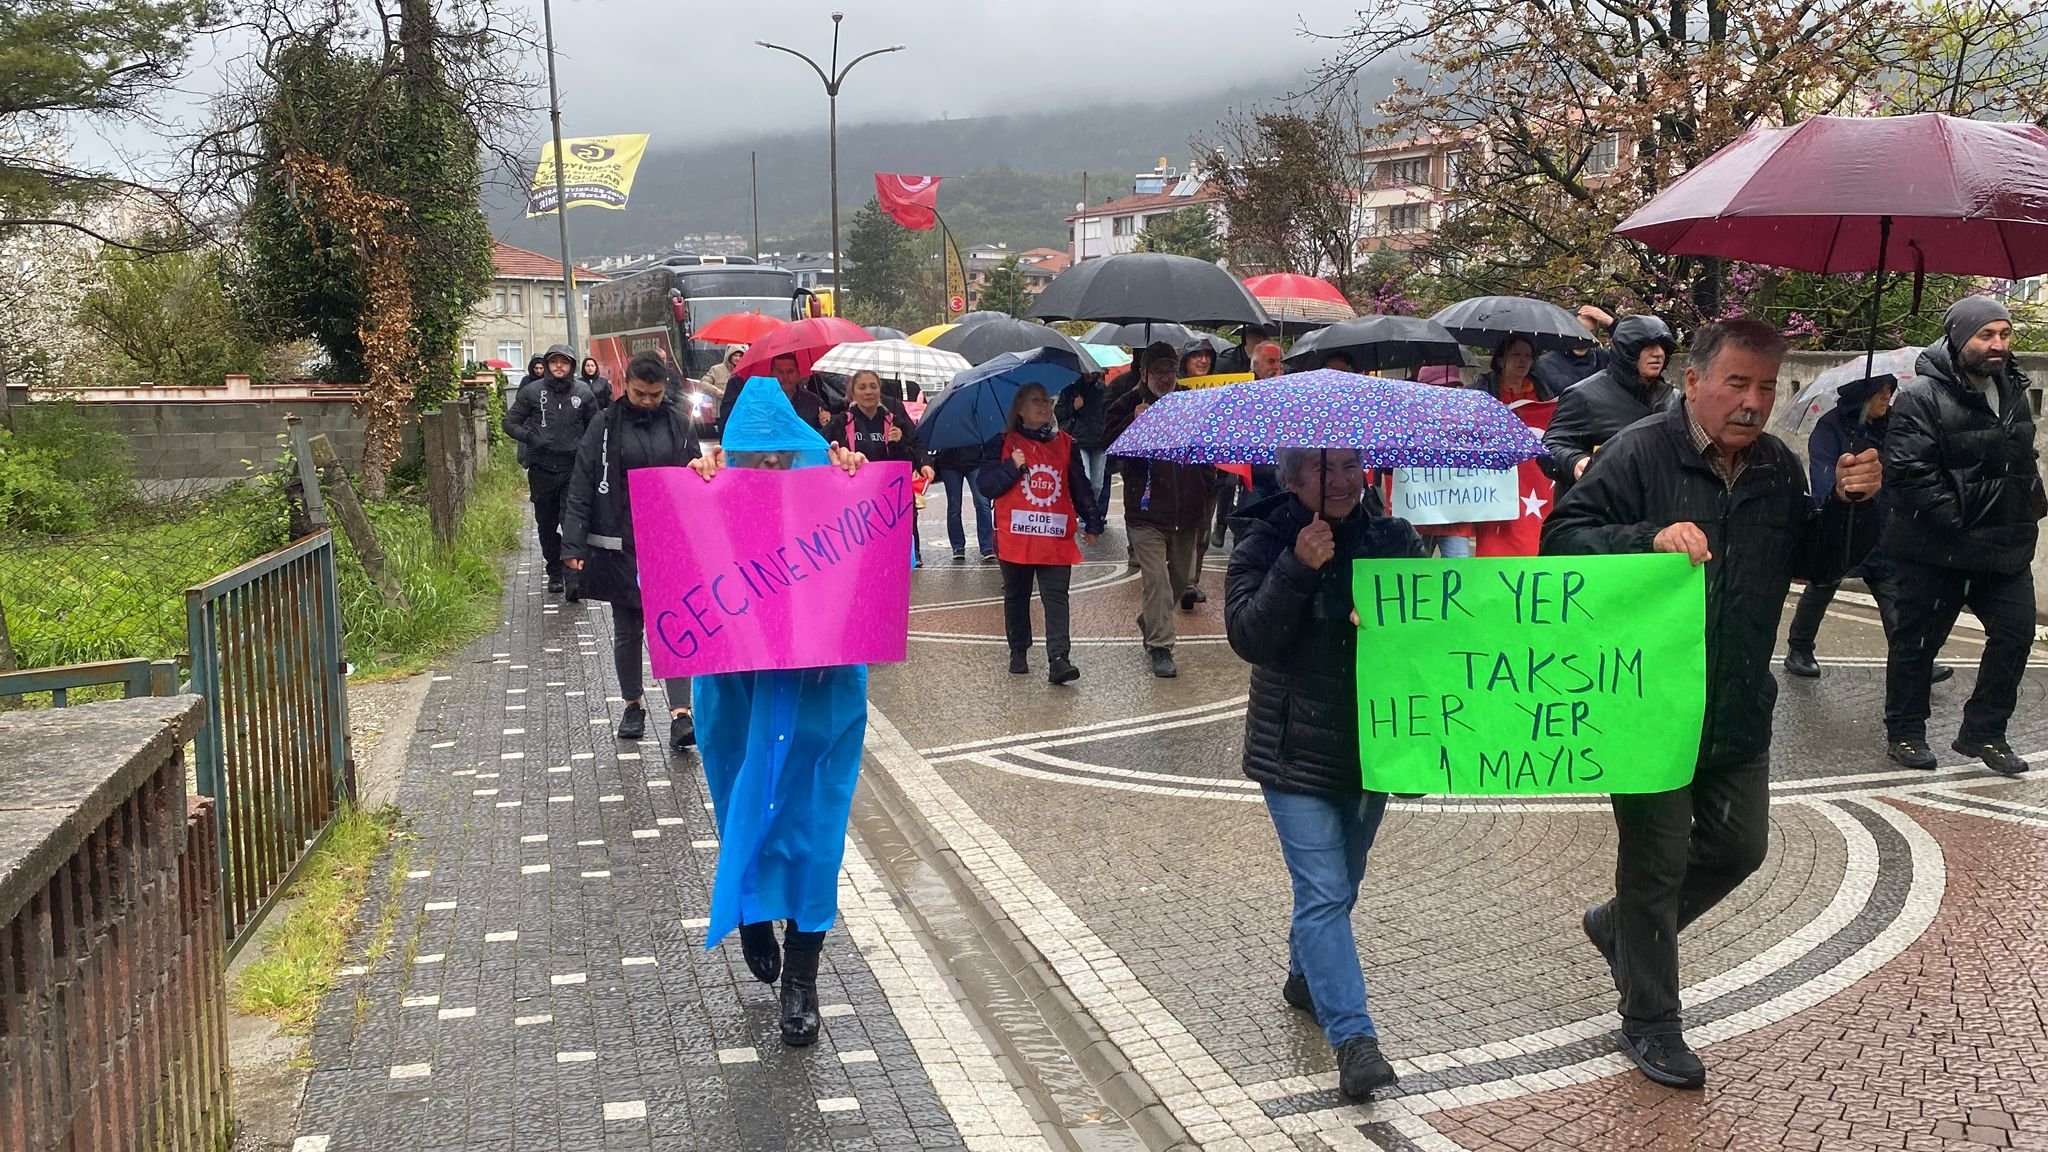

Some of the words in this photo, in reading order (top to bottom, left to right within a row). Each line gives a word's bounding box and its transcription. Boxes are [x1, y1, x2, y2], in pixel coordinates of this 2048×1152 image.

[1030, 477, 1055, 491] DİSK
[1406, 486, 1501, 510] UNUTMADIK
[1012, 524, 1065, 536] EMEKLİ-SEN
[1028, 513, 1052, 524] CİDE
[1374, 569, 1475, 626] HER
[1499, 570, 1594, 625] YER
[1448, 644, 1643, 699] TAKSİM
[1369, 694, 1476, 738] HER
[1514, 700, 1603, 742] YER
[1439, 745, 1453, 794] 1
[1479, 745, 1604, 790] MAYIS
